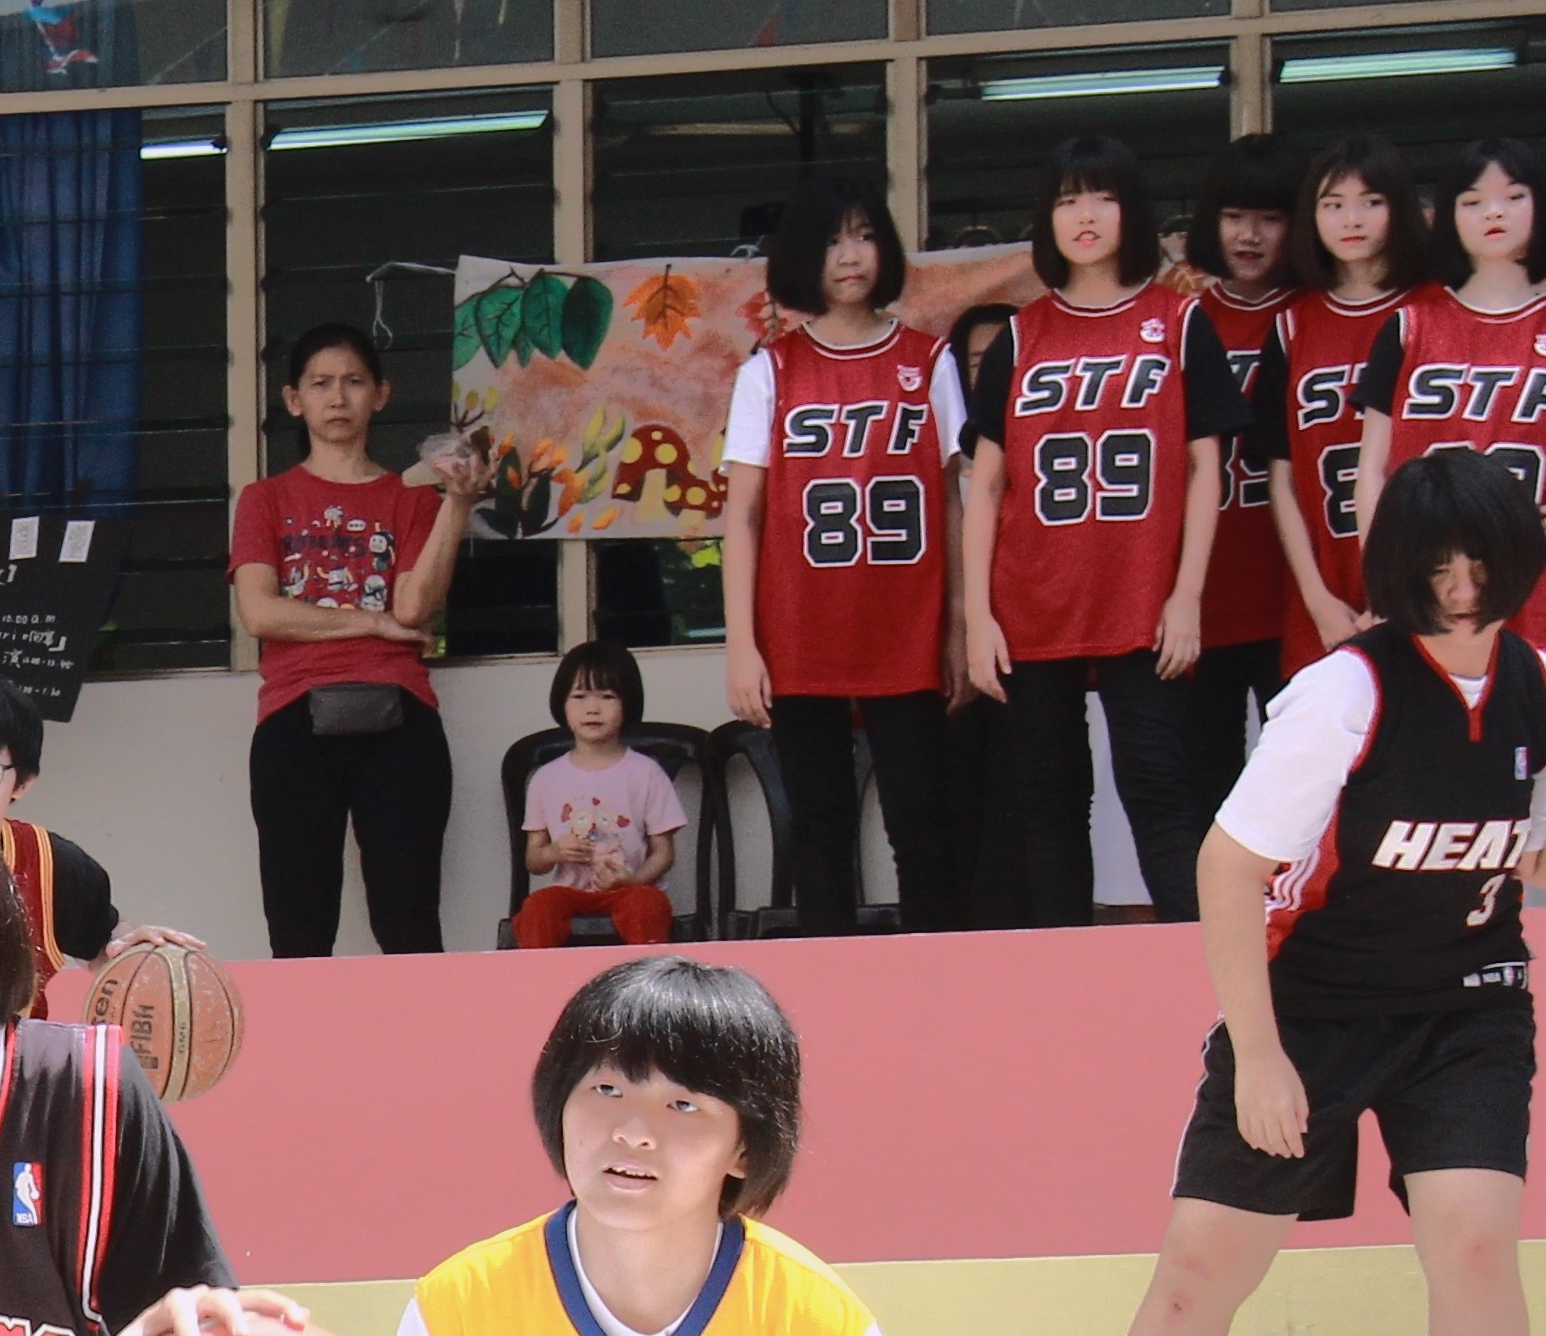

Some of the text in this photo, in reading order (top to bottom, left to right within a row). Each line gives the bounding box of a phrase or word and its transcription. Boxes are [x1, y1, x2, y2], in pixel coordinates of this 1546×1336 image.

[1015, 353, 1171, 417] STF
[782, 399, 928, 459] STF
[1033, 428, 1154, 527] 89
[802, 474, 926, 568] 89
[1466, 873, 1506, 927] 3
